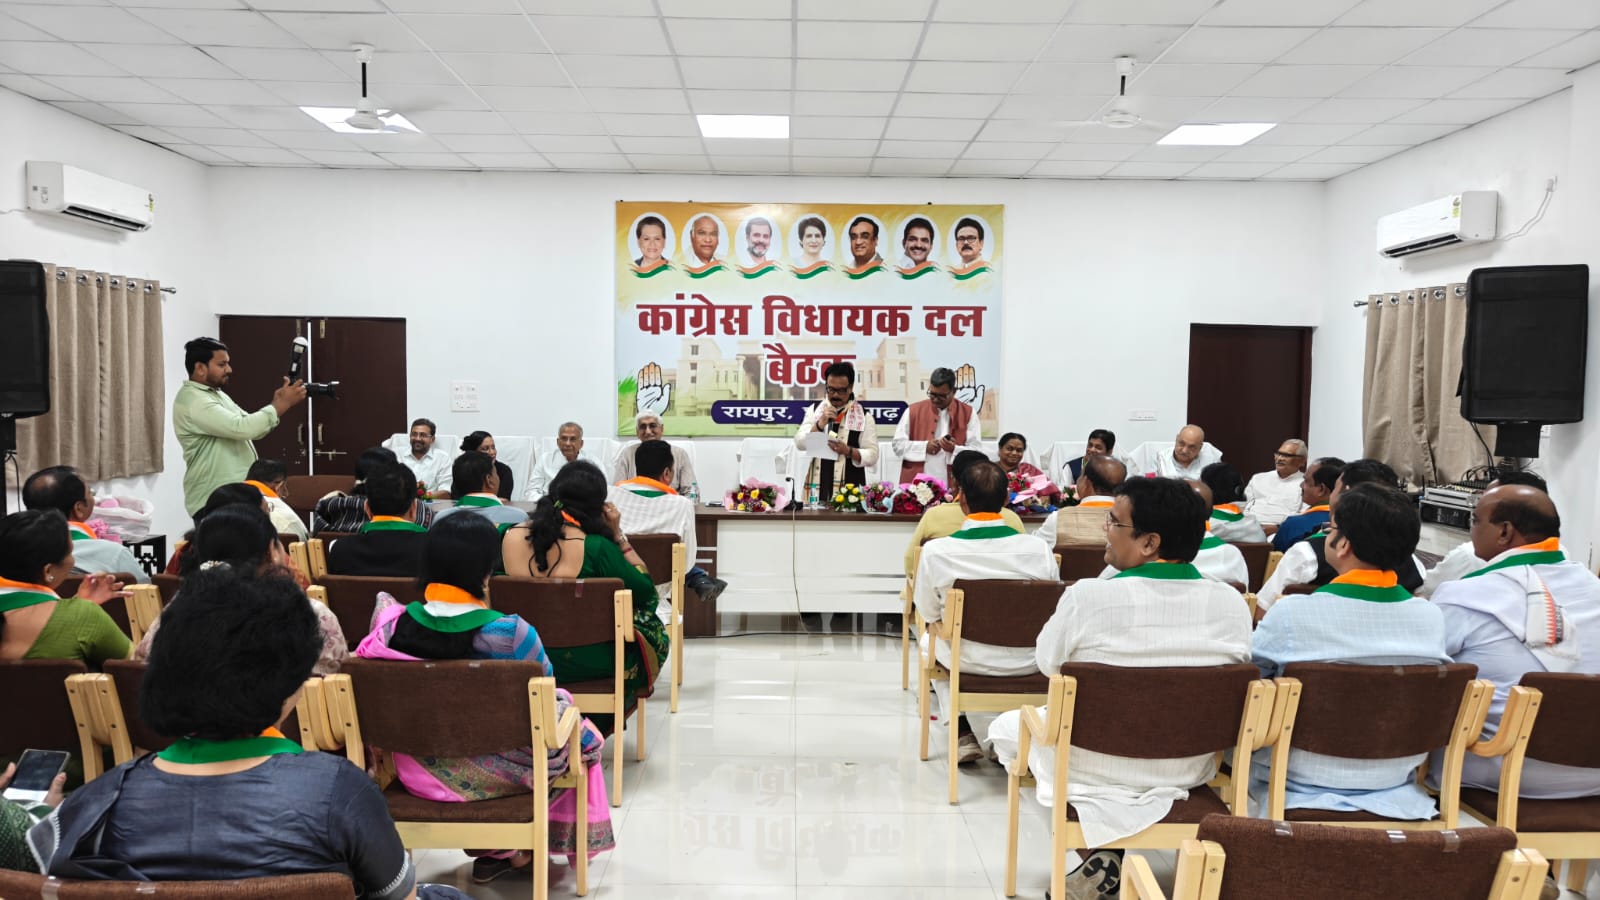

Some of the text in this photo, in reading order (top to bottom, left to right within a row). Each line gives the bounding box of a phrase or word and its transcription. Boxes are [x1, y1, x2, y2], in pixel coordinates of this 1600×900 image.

[636, 293, 987, 338] कांग्रेस विधायक दल
[721, 406, 793, 421] रायपुर,
